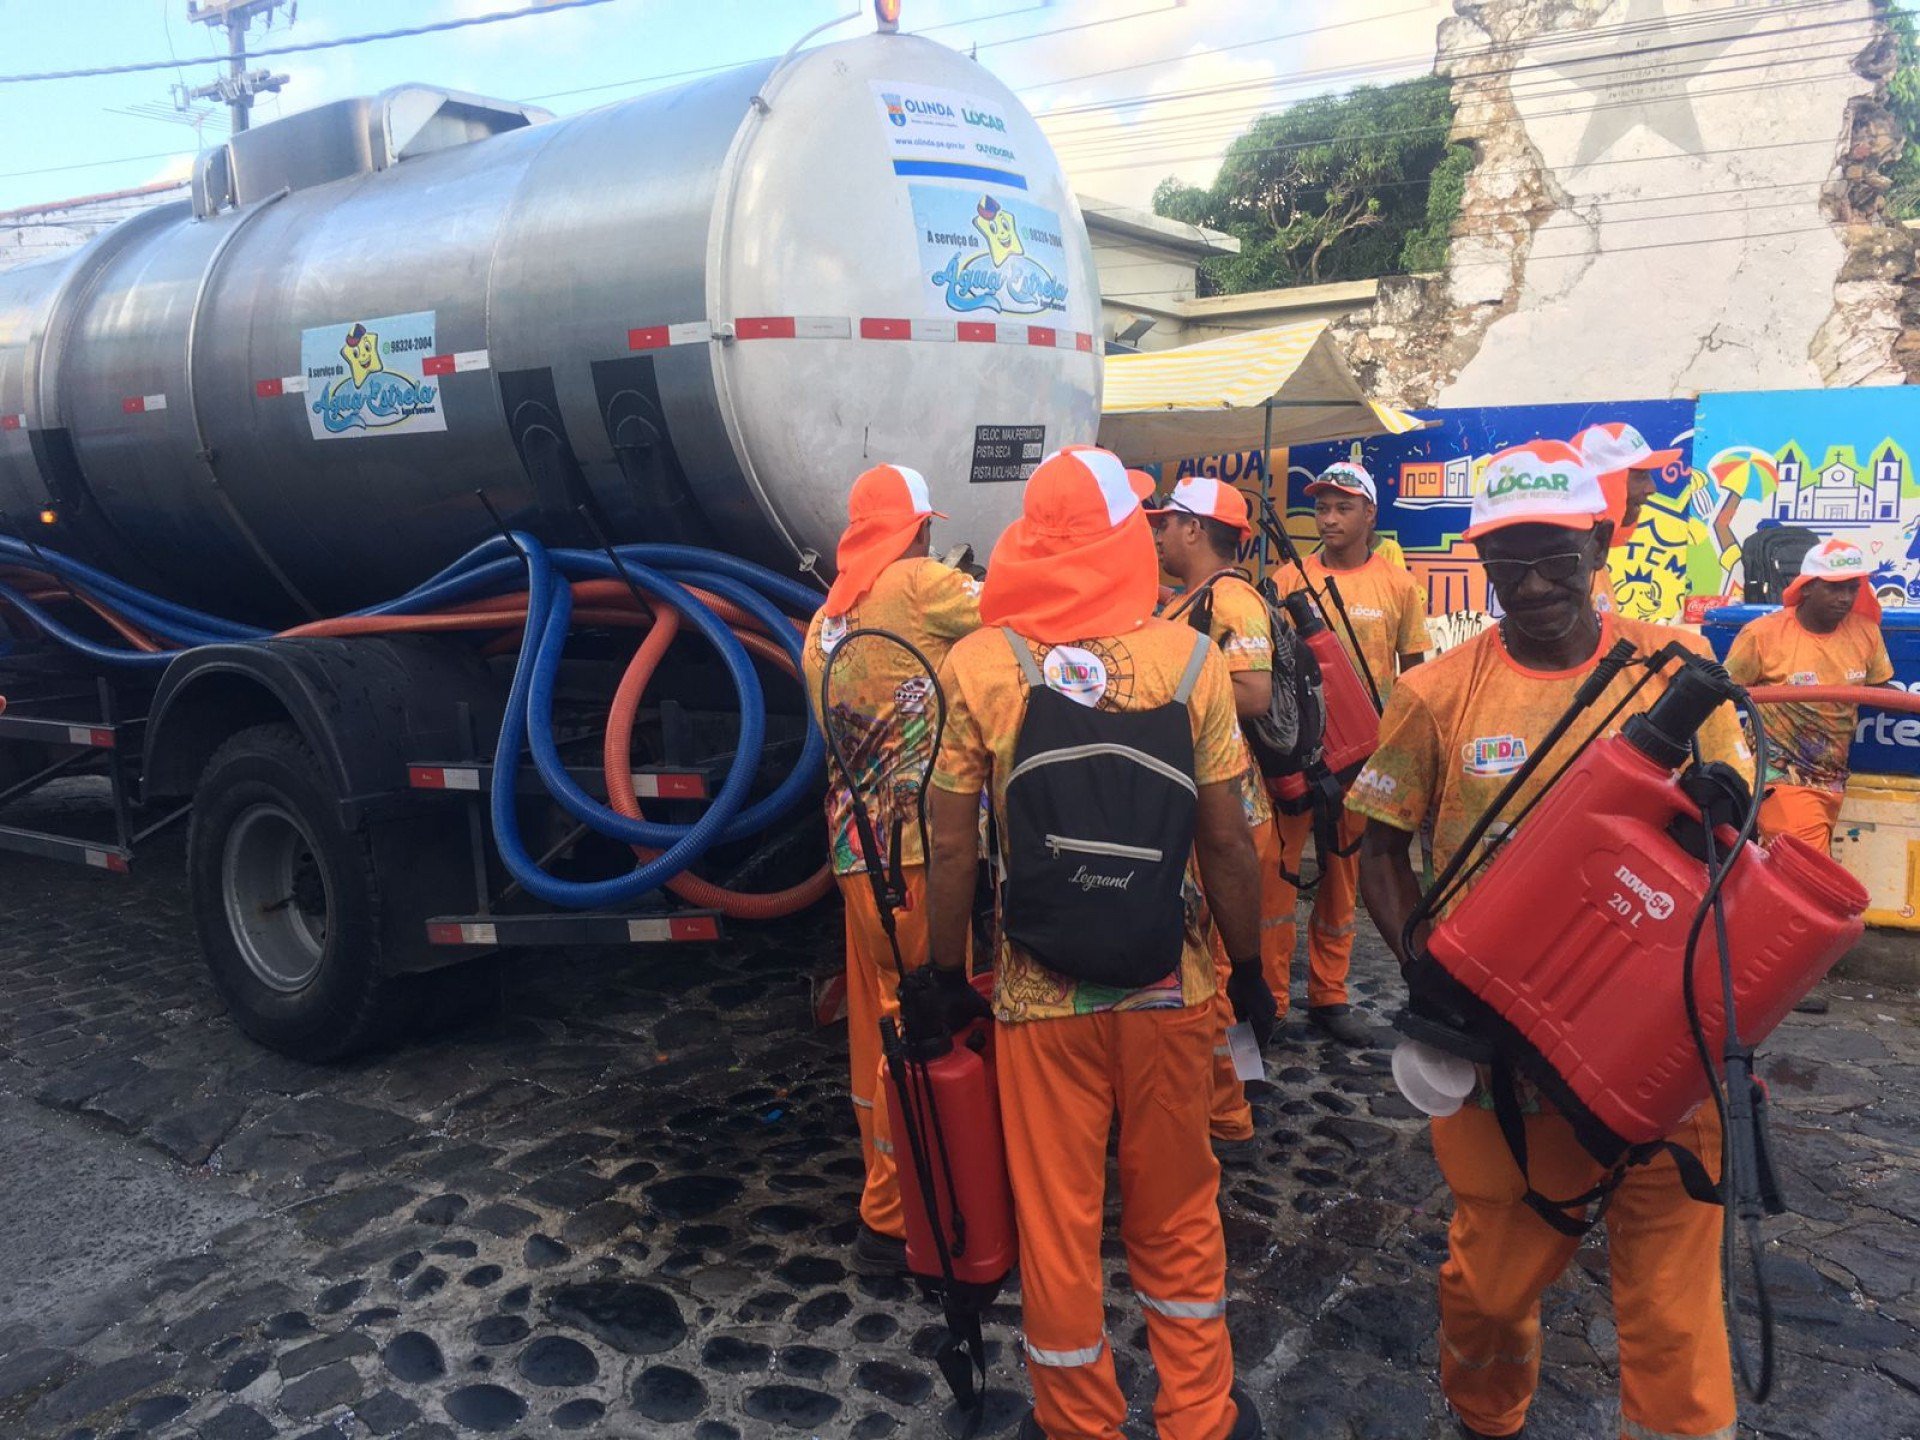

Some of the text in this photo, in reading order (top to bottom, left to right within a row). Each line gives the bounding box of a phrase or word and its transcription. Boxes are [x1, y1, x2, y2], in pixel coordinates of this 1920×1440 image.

[904, 99, 955, 118] OLINDA
[960, 107, 1007, 133] LOCAR
[927, 230, 979, 248] A serviço da
[308, 364, 344, 379] A serviço da
[1486, 472, 1569, 499] LOCAR
[1350, 606, 1384, 618] LOCAR
[1048, 663, 1099, 685] OLINDA
[1461, 738, 1526, 766] OLINDA
[1068, 864, 1135, 892] Legrand
[1607, 892, 1643, 929] 20 L
